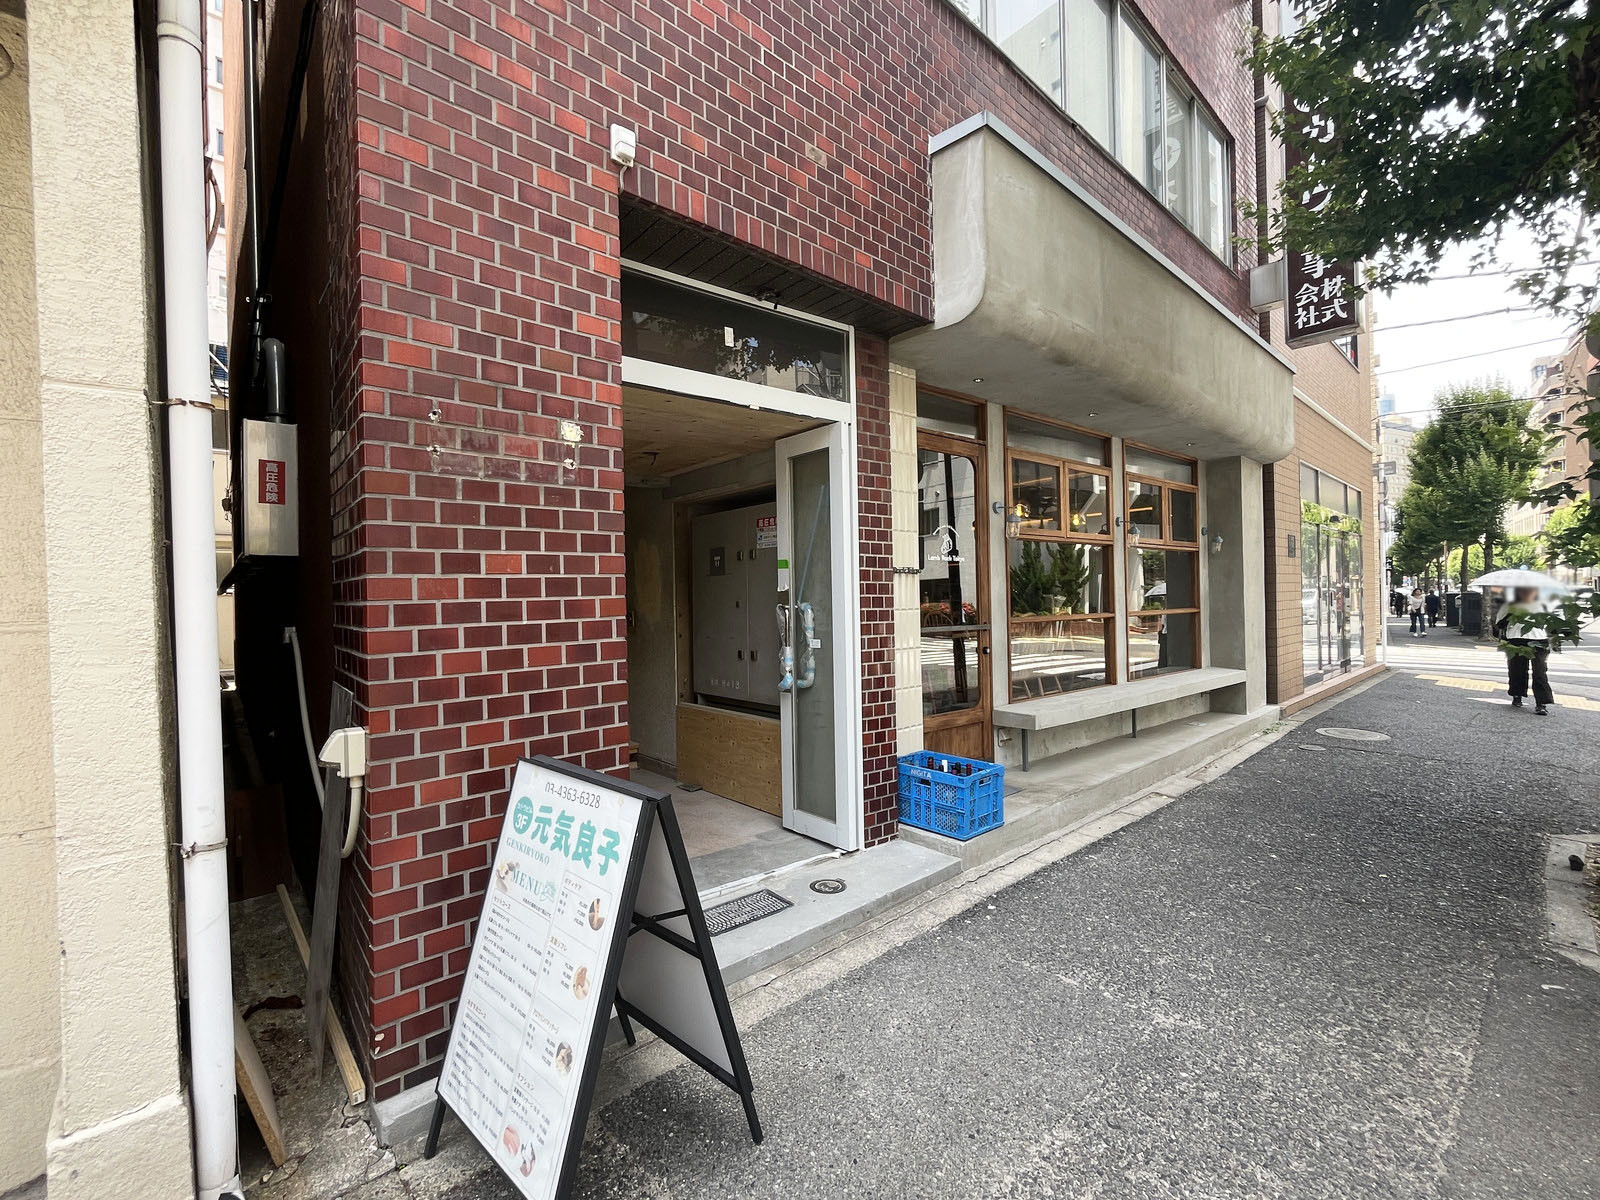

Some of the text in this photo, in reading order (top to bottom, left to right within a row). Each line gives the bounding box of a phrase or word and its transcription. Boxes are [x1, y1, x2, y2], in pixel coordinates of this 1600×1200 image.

[265, 462, 279, 503] 高圧危険
[544, 781, 601, 809] 03-4363-6328
[515, 813, 529, 829] 3F
[506, 836, 550, 865] GENKIRYOKO
[530, 805, 621, 877] 元気良子
[511, 867, 542, 896] MENU
